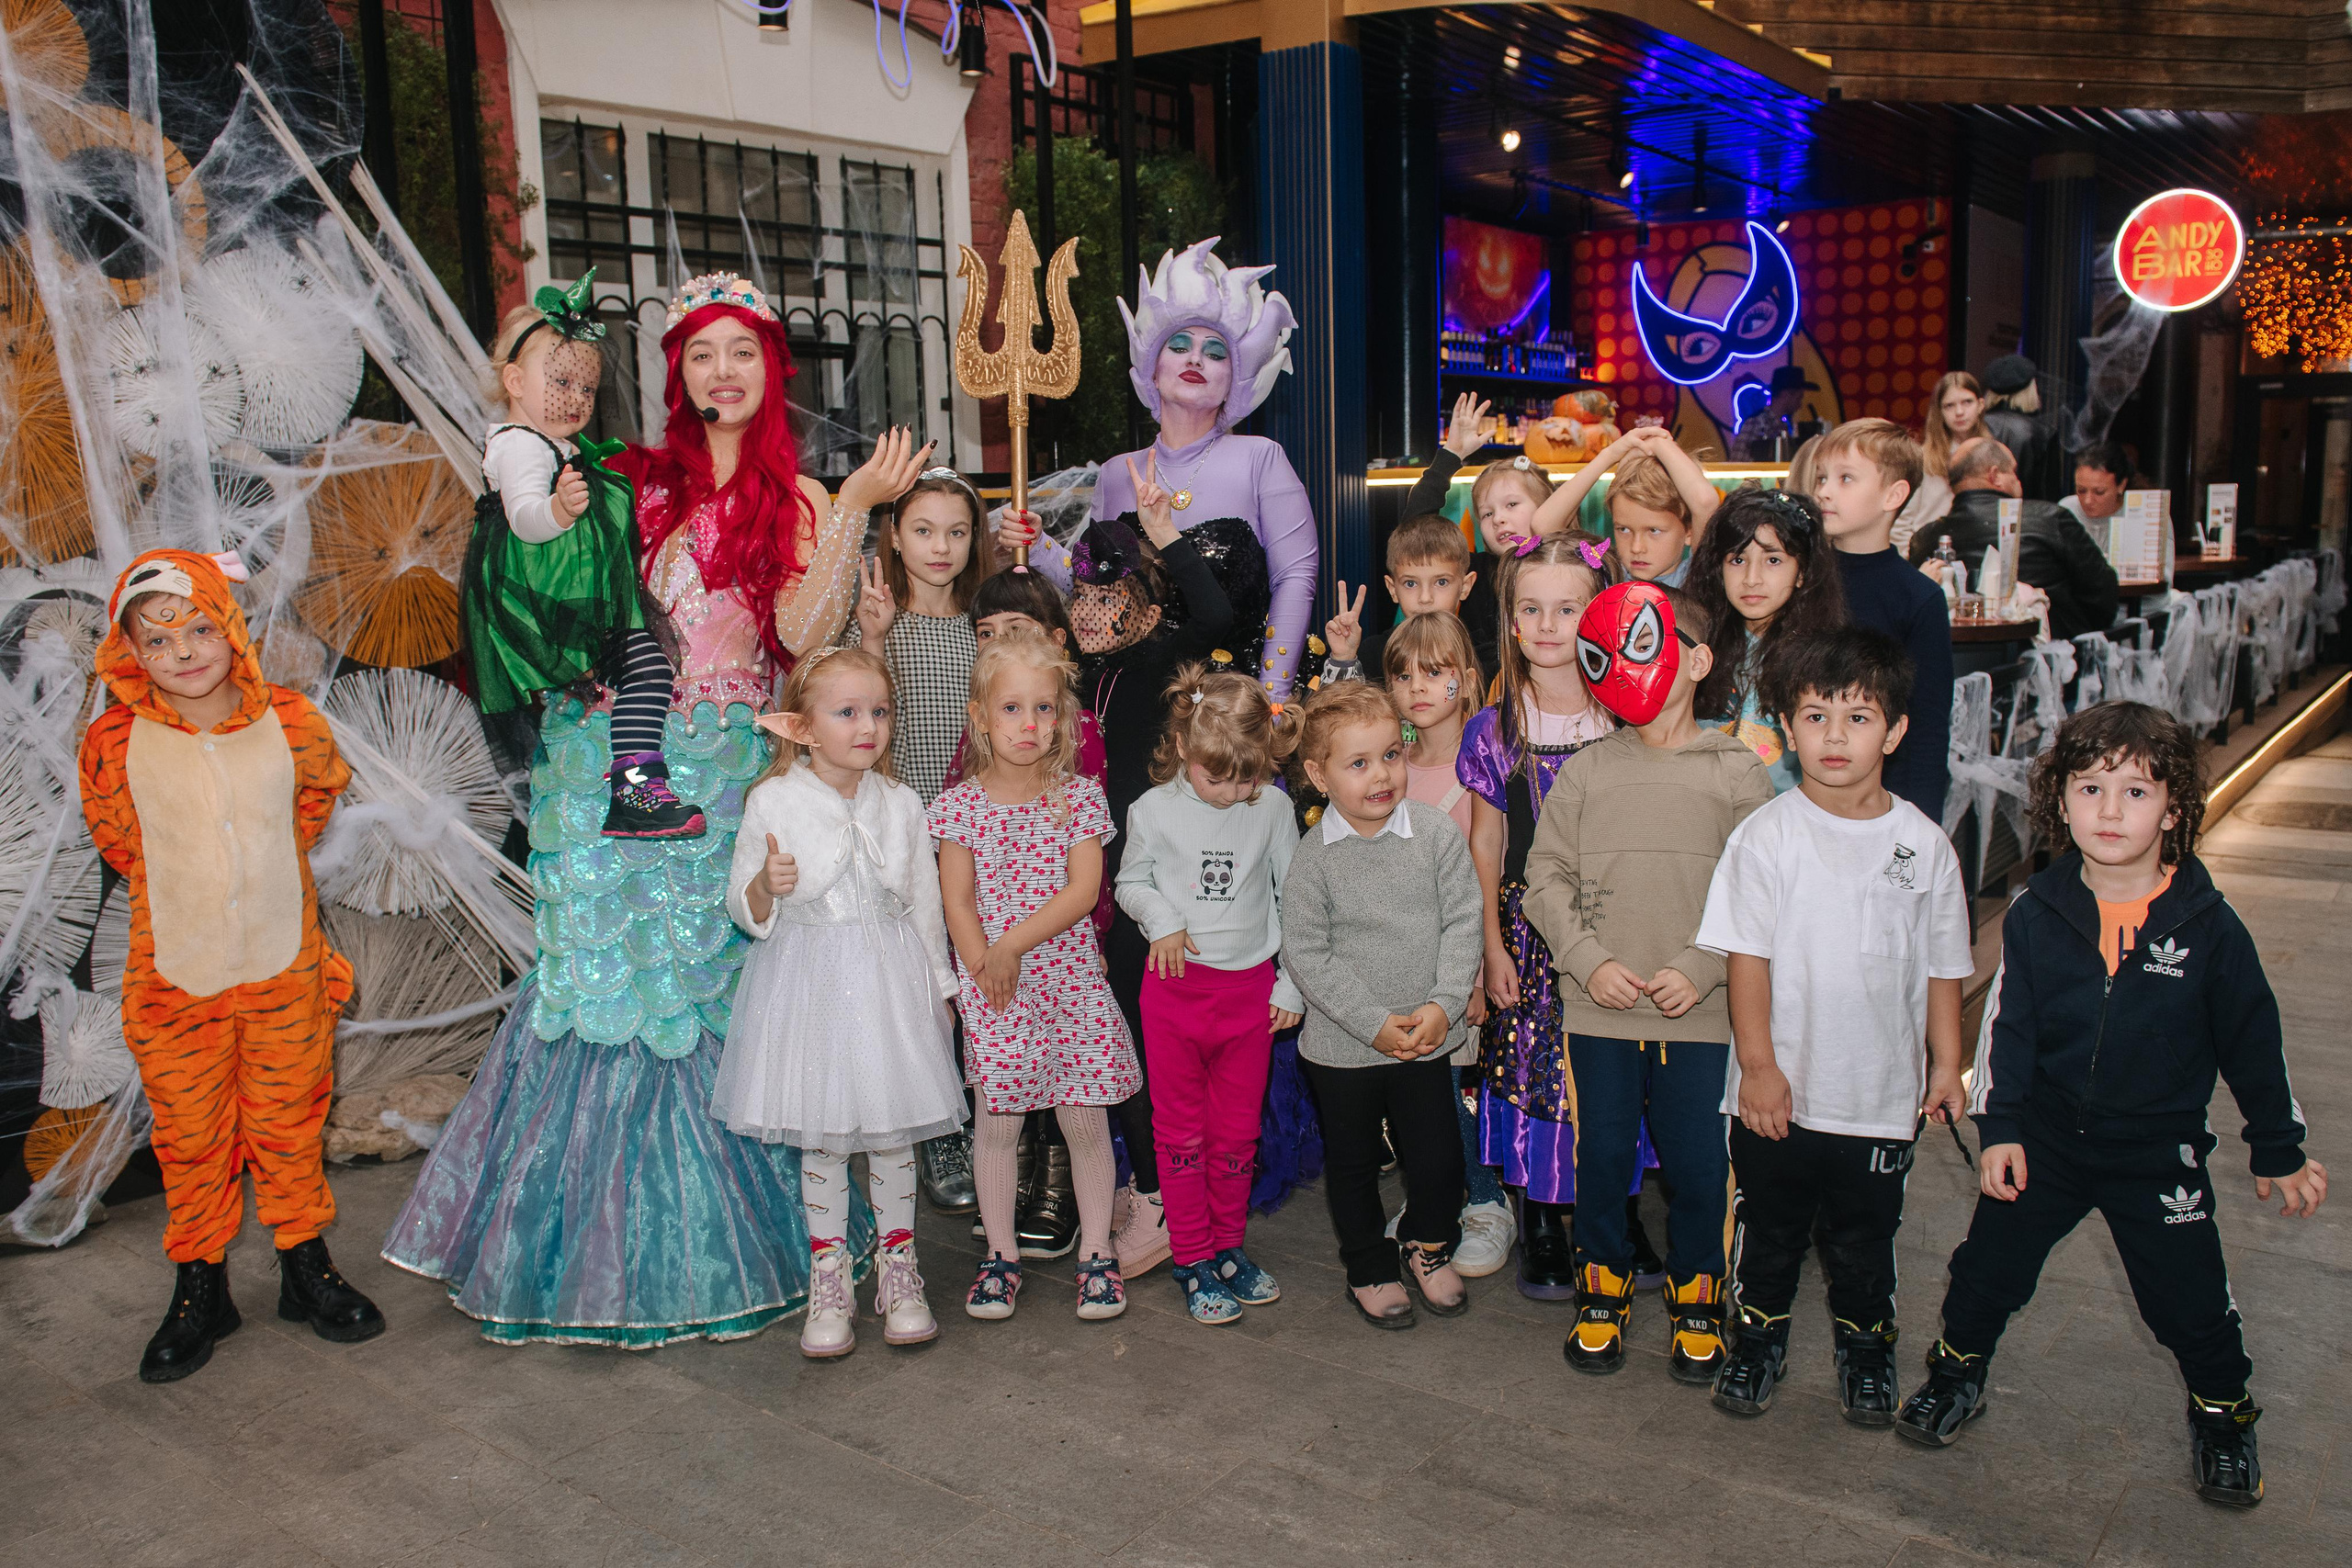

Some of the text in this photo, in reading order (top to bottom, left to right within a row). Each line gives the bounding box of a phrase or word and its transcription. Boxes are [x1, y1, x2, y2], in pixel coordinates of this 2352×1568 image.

[2132, 220, 2225, 254] ANDY
[2132, 249, 2202, 281] BAR
[2143, 963, 2184, 978] adidas
[2164, 1211, 2207, 1224] adidas
[1591, 1309, 1610, 1319] KKD
[1689, 1319, 1708, 1330] KKD
